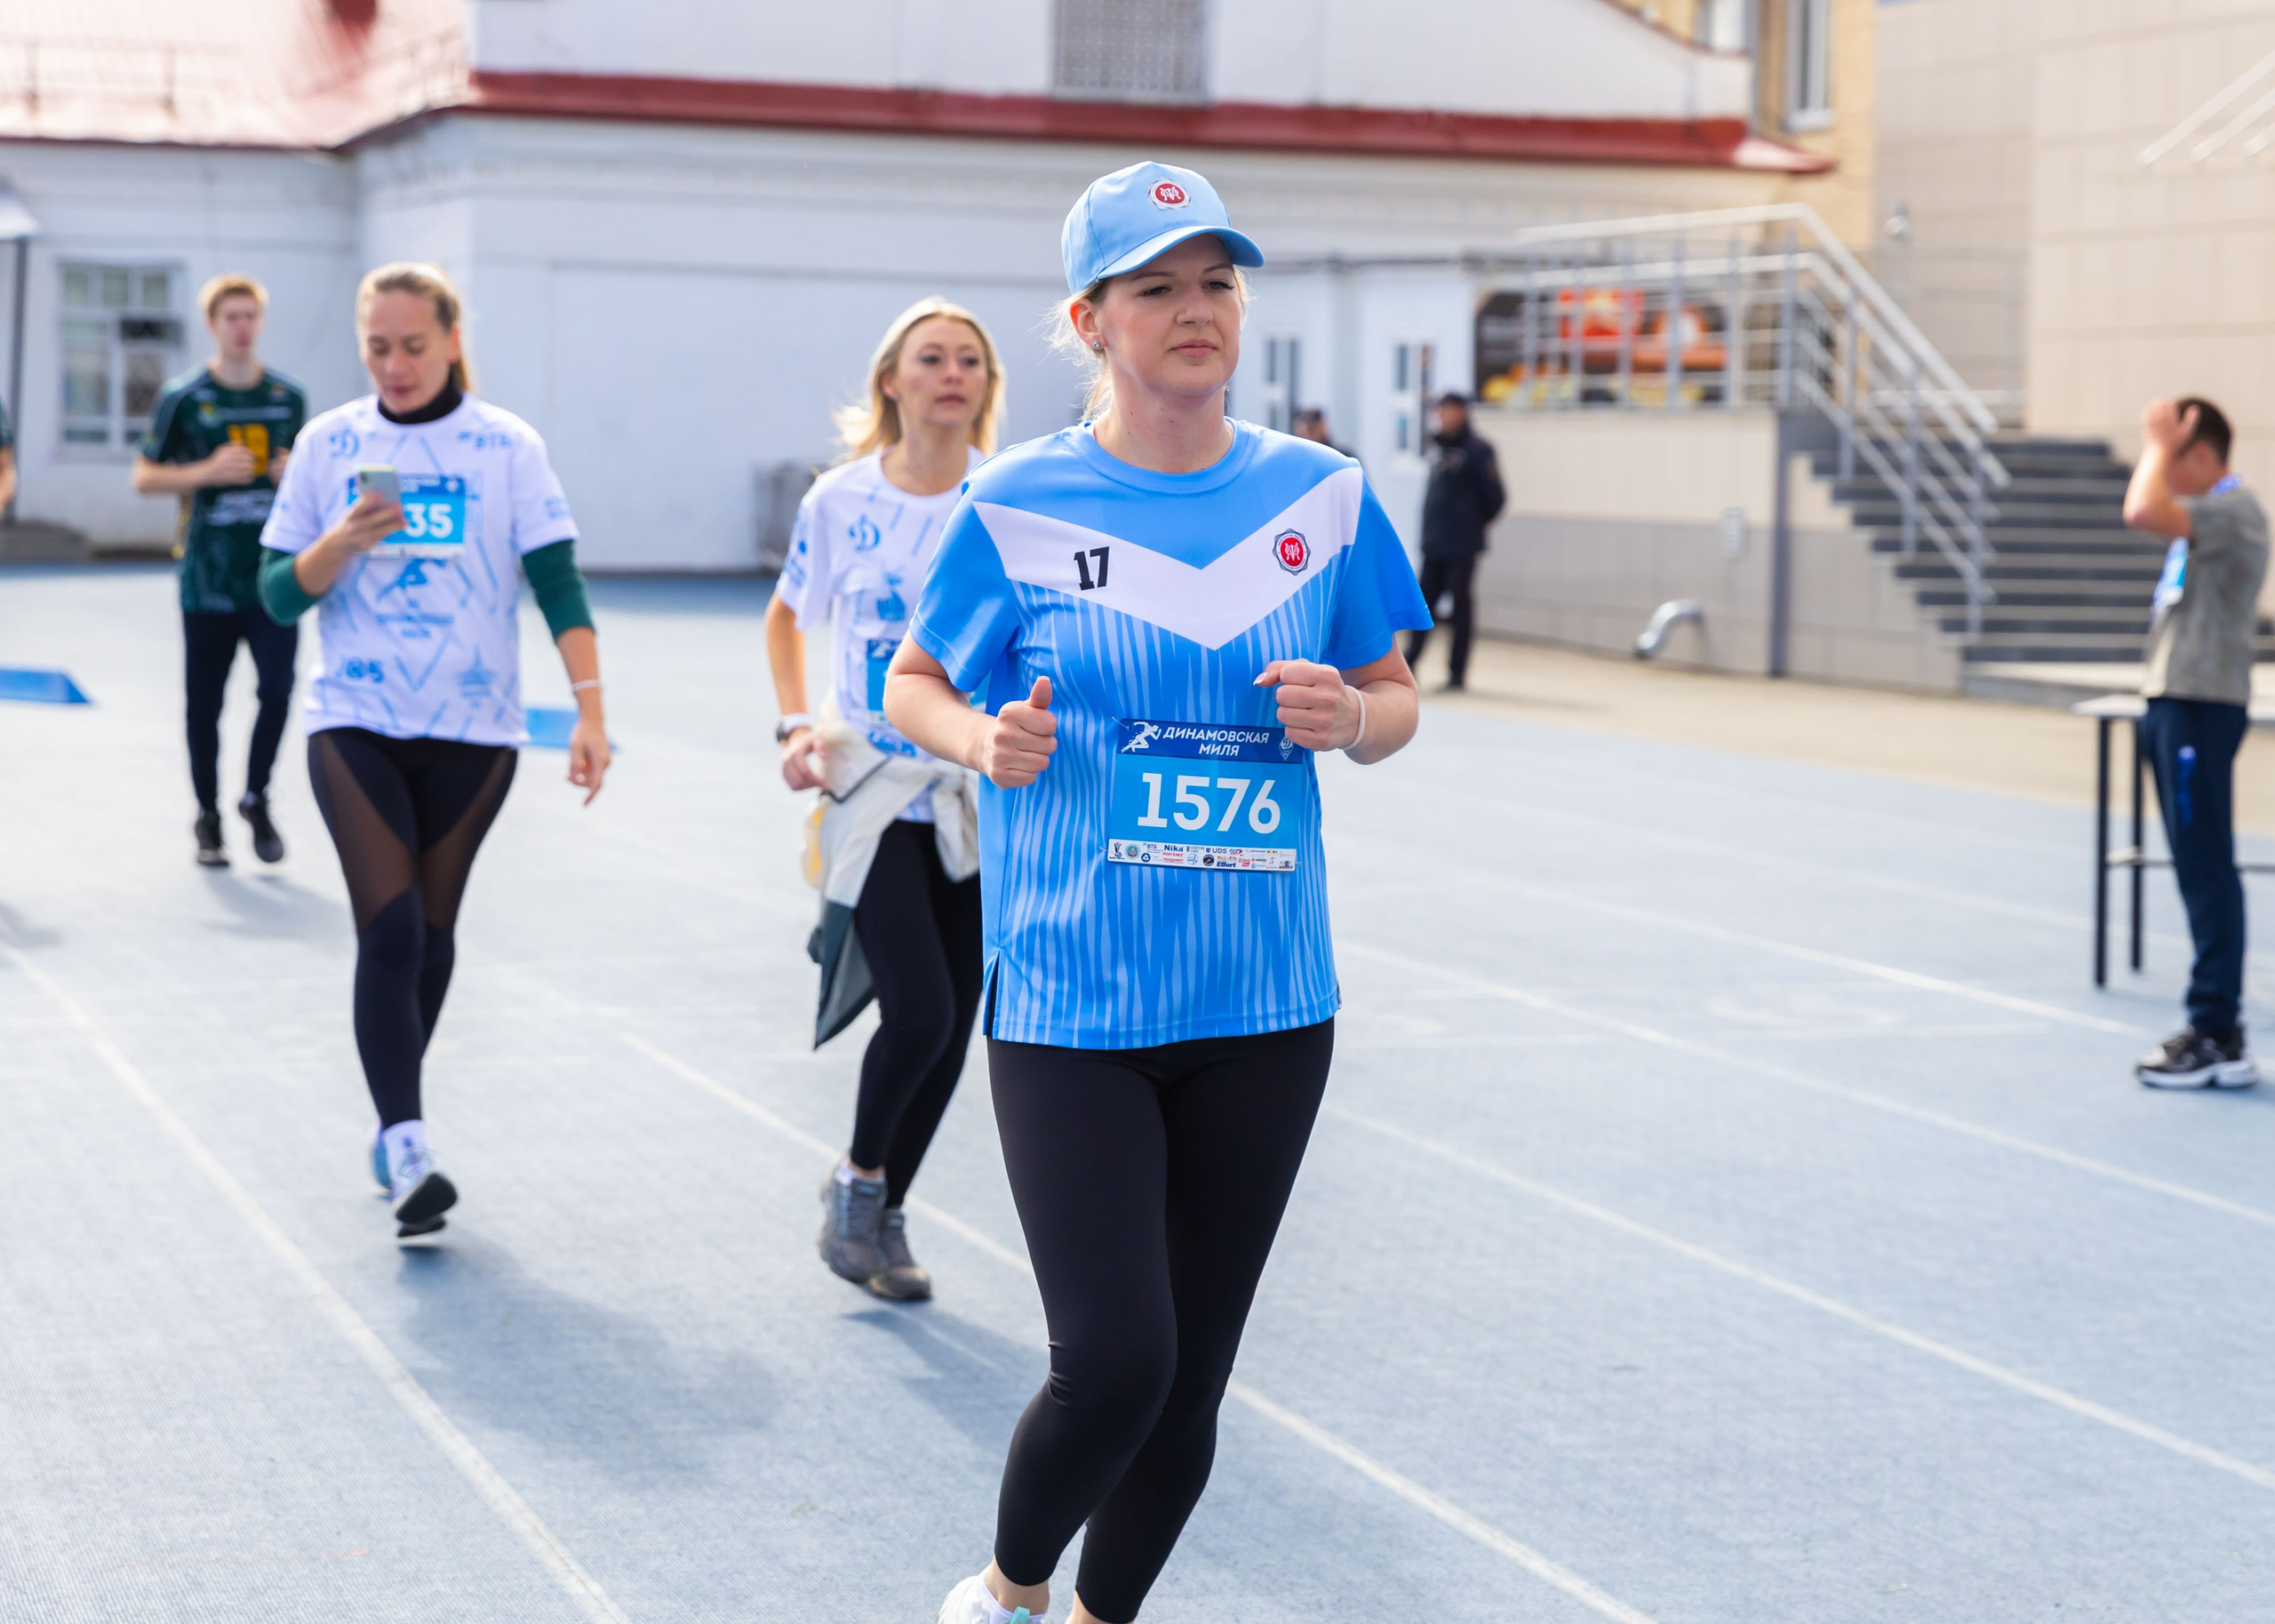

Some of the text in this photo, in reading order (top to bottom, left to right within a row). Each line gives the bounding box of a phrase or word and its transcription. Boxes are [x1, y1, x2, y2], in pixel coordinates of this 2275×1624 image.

[403, 503, 453, 538] 35
[1074, 545, 1110, 592] 17
[1162, 726, 1270, 744] ДИНАМОВСКАЯ
[1198, 744, 1240, 757] МИЛЯ
[1138, 772, 1281, 834] 1576
